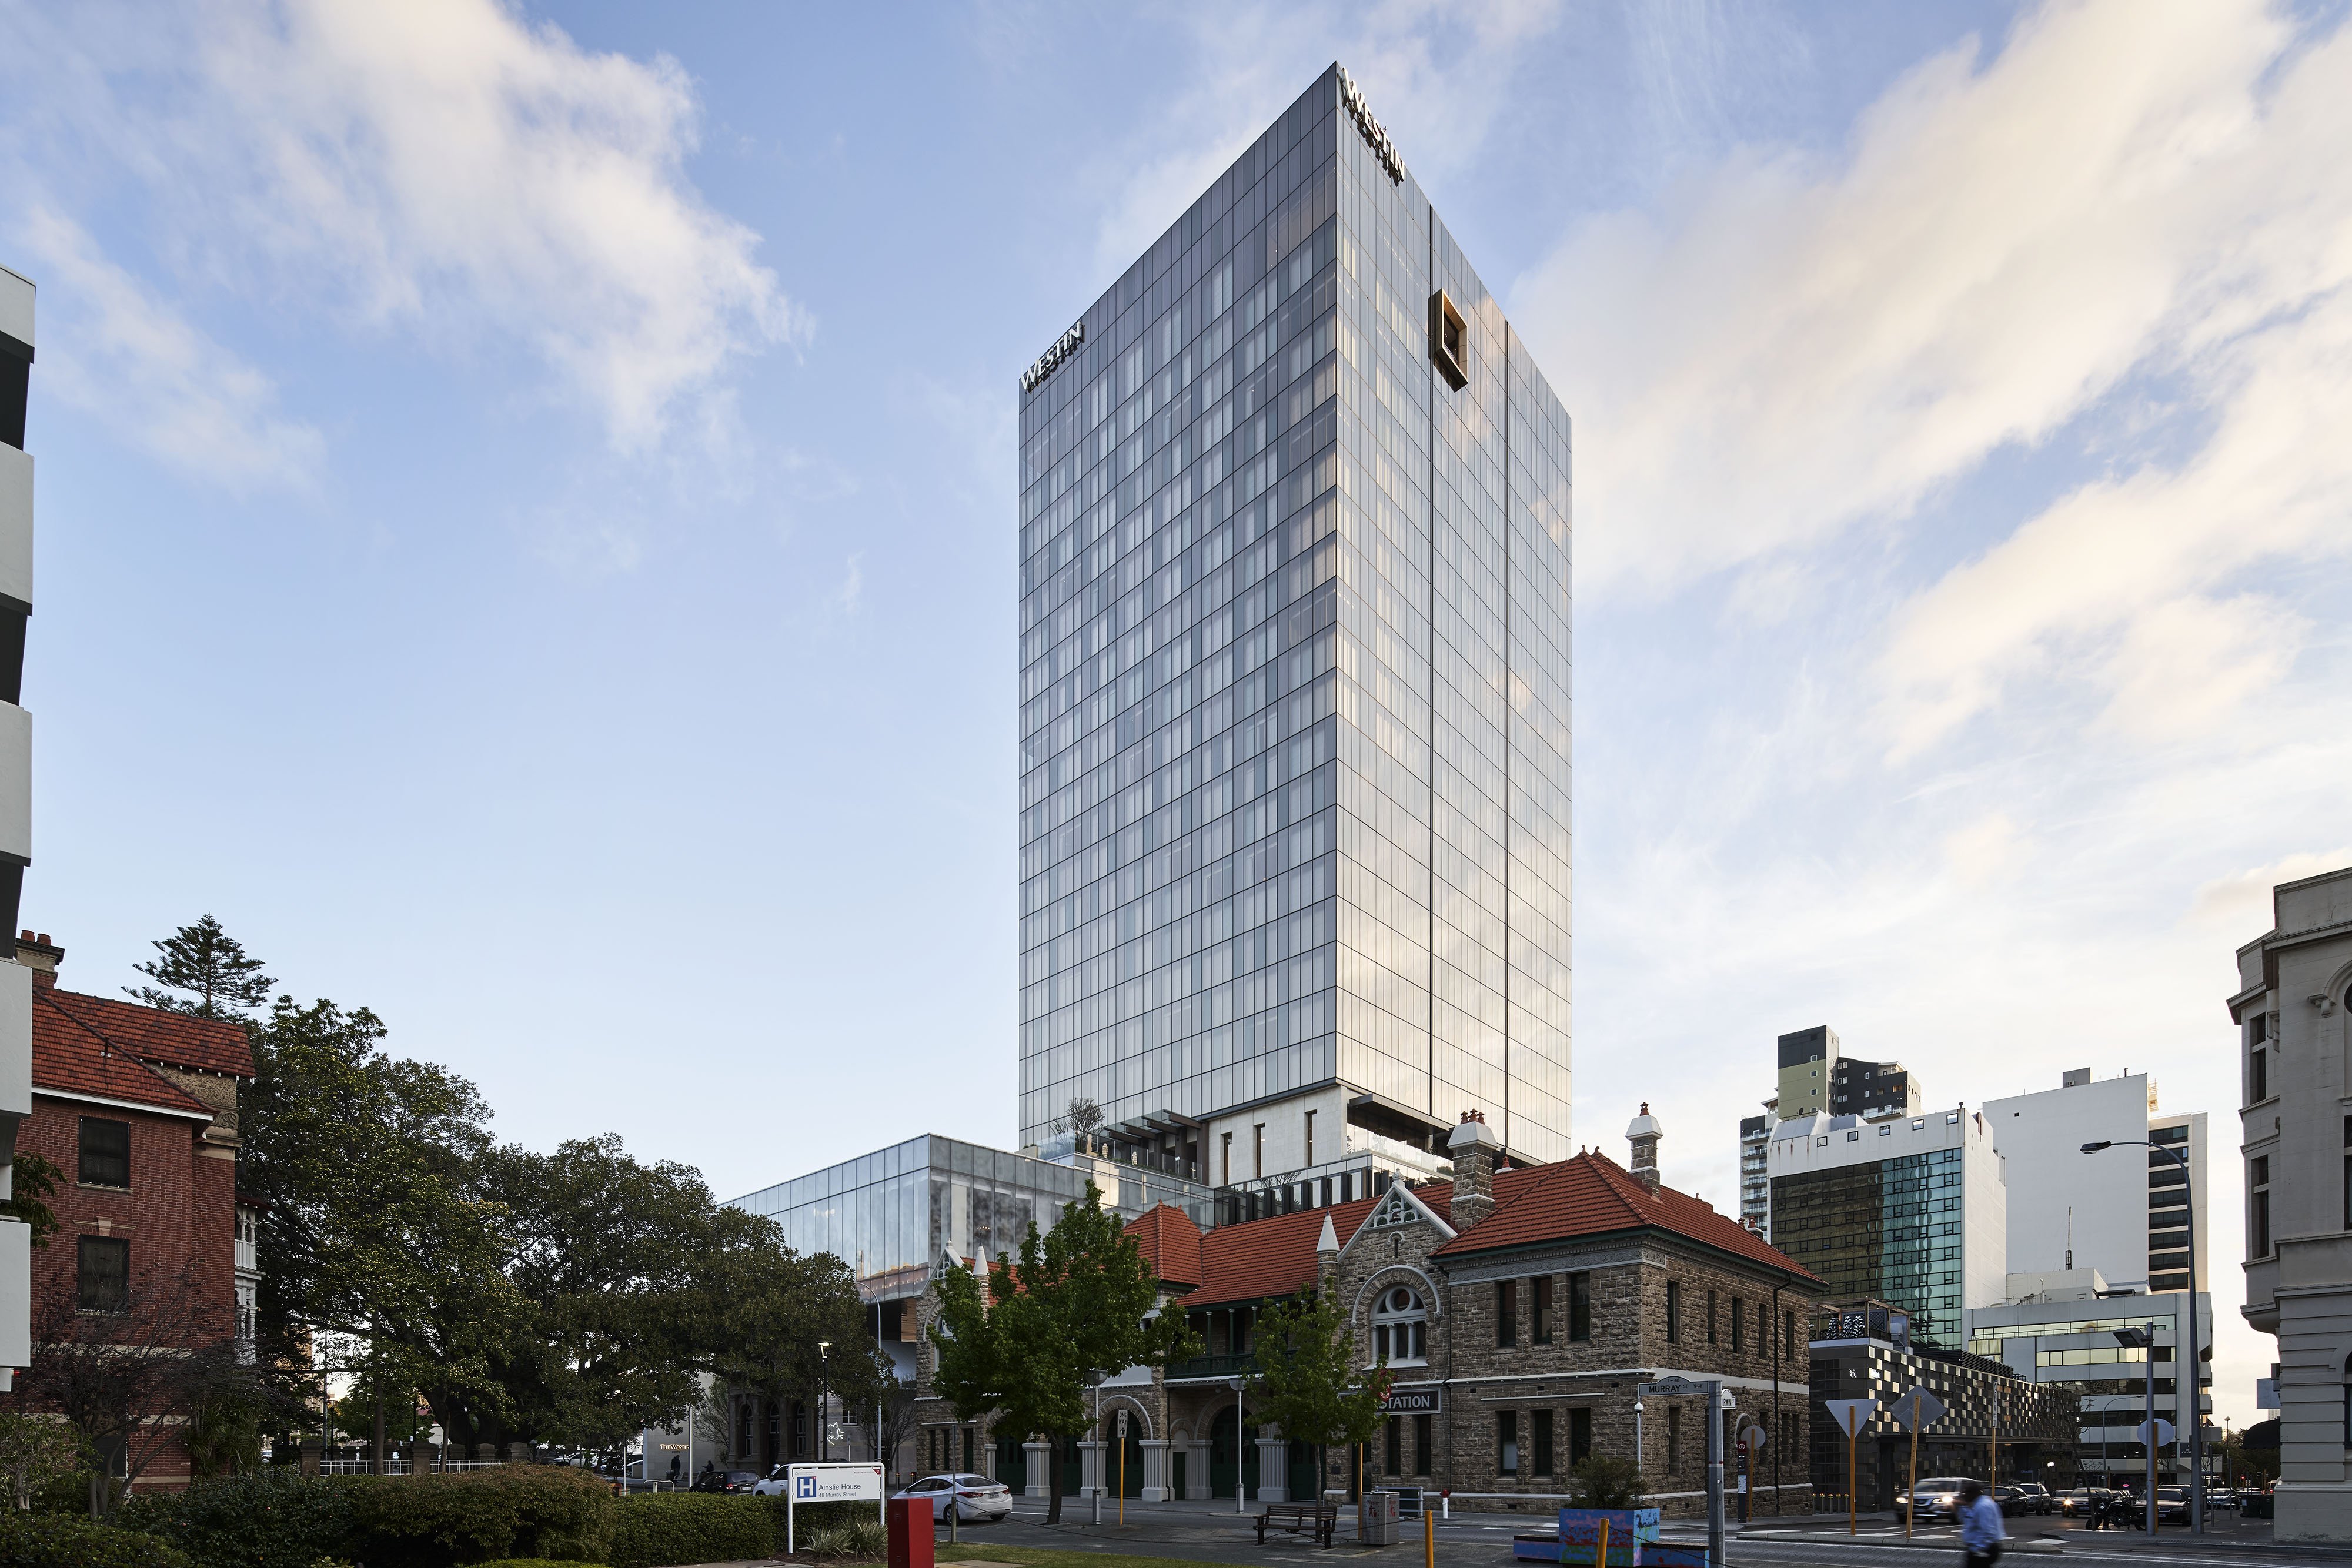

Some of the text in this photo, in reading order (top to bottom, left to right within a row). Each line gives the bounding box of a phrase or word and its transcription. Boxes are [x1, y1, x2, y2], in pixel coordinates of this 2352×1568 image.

[1342, 67, 1405, 182] WESTIN
[1020, 321, 1081, 390] WESTIN
[1649, 1385, 1681, 1393] MURRAY
[800, 1478, 813, 1496] H
